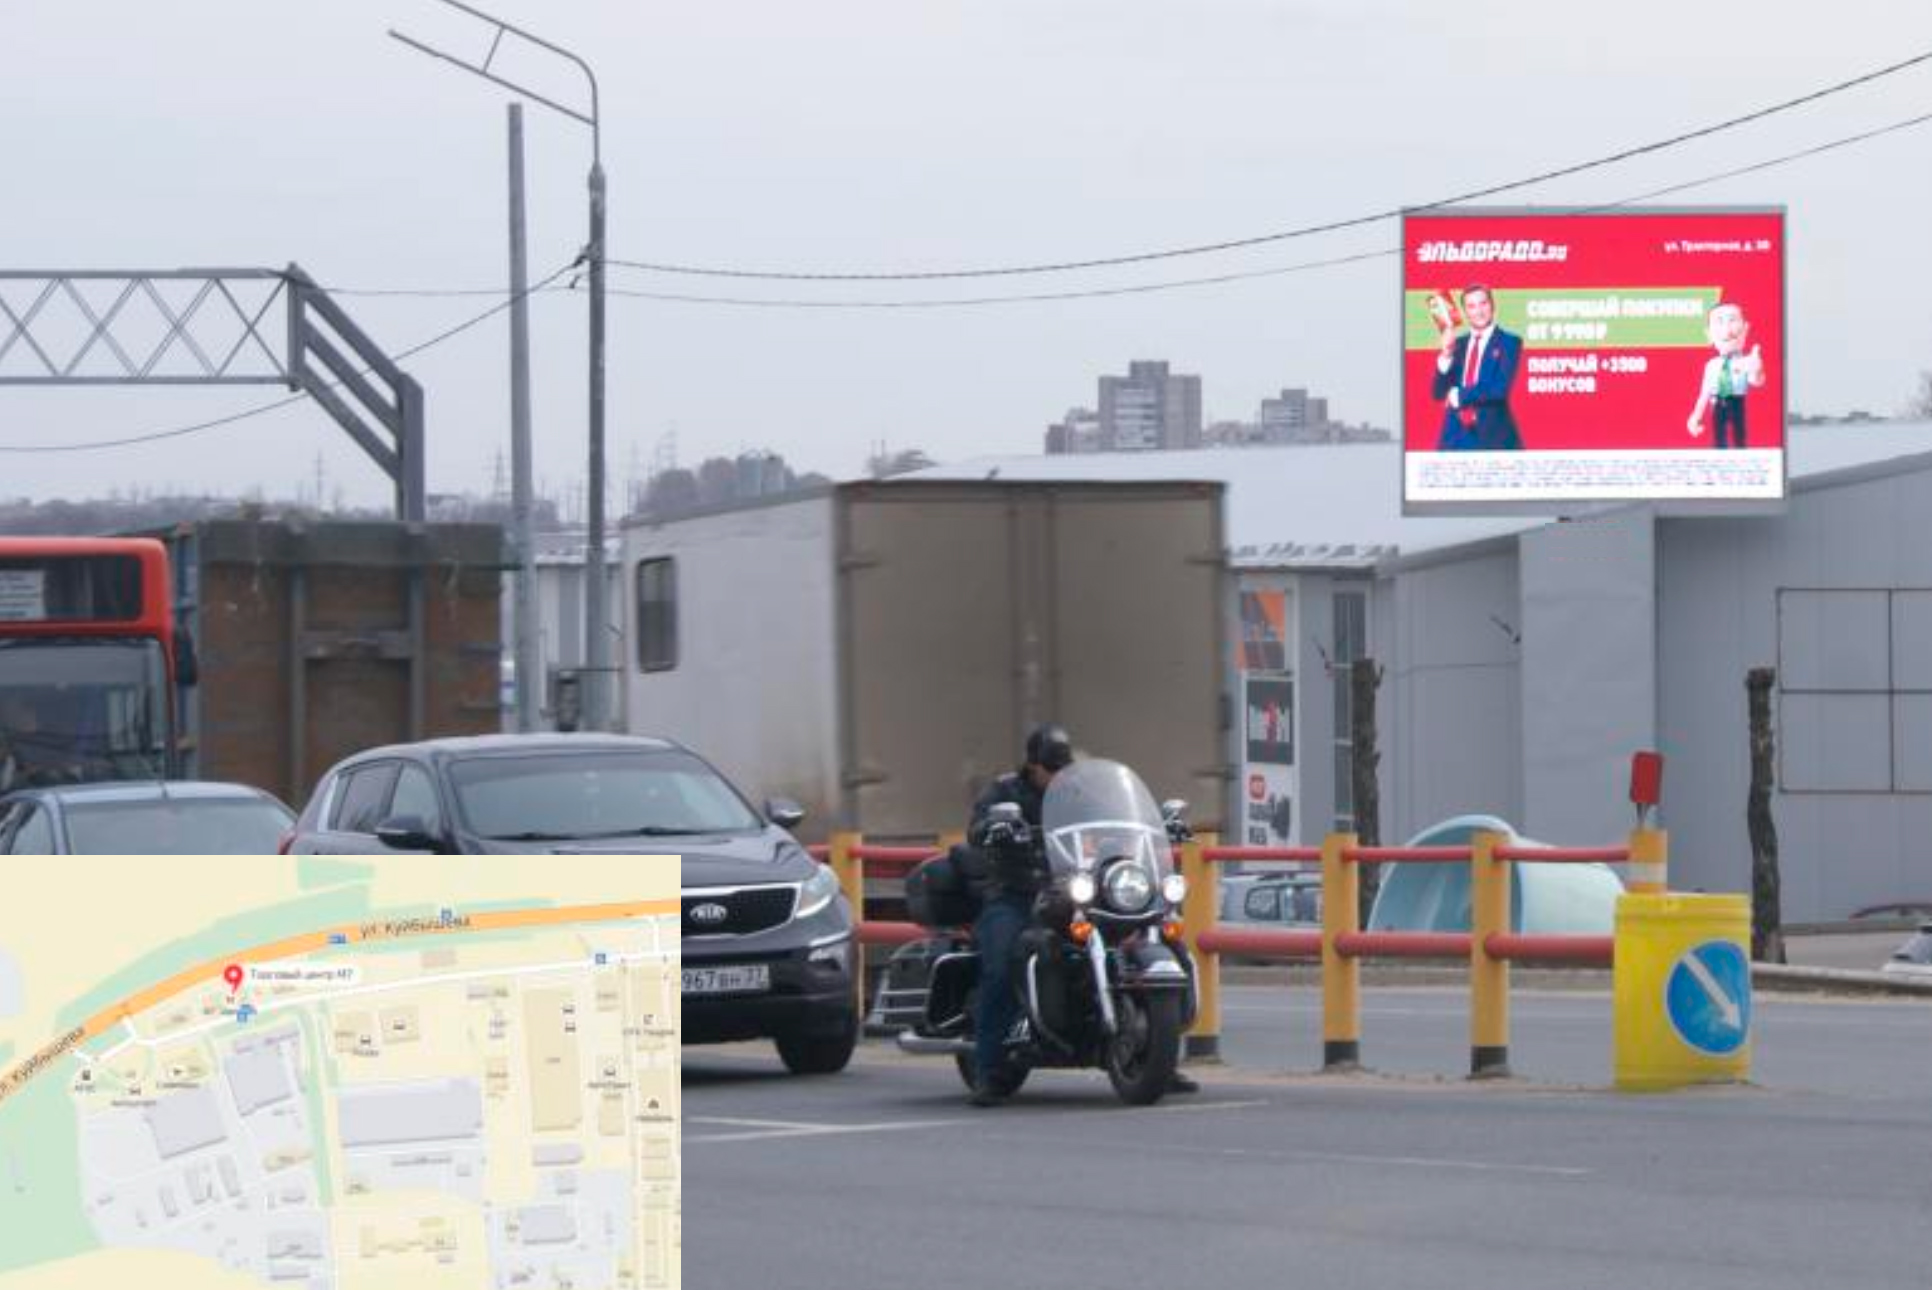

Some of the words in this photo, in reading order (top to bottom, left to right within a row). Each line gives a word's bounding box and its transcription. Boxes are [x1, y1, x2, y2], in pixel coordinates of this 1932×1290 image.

[1527, 296, 1619, 318] СОВЕРШАЙ
[1621, 298, 1703, 317] ПОКУПКИ
[1527, 322, 1548, 340] ОТ
[1528, 353, 1598, 373] ПОЛУЧАЙ
[1528, 376, 1597, 393] БОНУСОВ
